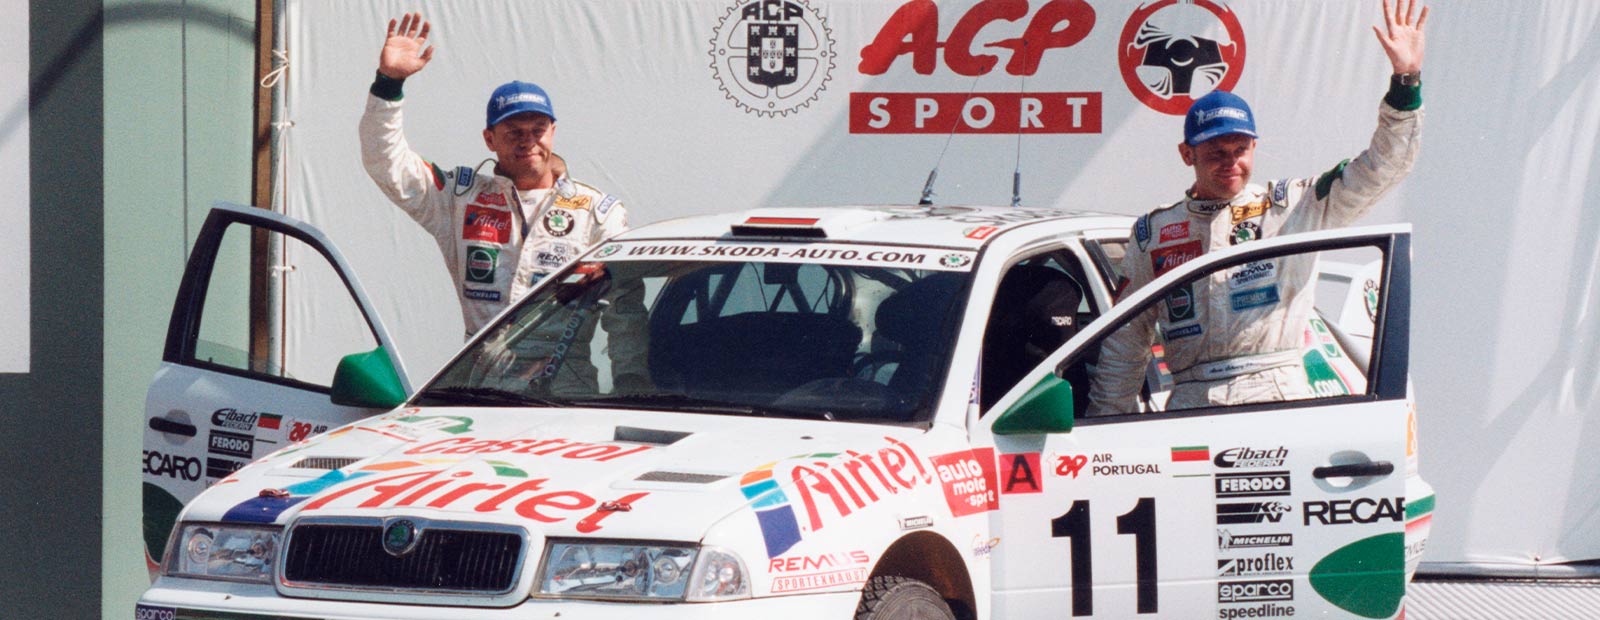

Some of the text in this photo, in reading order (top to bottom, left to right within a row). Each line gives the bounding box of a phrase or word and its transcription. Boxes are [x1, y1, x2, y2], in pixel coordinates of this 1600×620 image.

[742, 0, 804, 21] ACP
[858, 0, 1097, 77] ACP
[867, 96, 1089, 129] SPORT
[628, 244, 926, 264] WWW.SKODA-AUTO.COM
[210, 407, 258, 427] Eibach
[312, 425, 329, 434] AIR
[211, 435, 250, 452] FERODO
[404, 436, 652, 462] Castrol
[1091, 452, 1114, 464] AIR
[1213, 445, 1289, 468] Eibach
[937, 459, 983, 483] auto
[1005, 454, 1039, 492] A
[1092, 463, 1161, 476] PORTUGAL
[790, 436, 933, 532] Airtel
[1220, 476, 1286, 492] FERODO
[299, 469, 652, 534] Airtel
[1232, 534, 1292, 546] MICHELIN
[767, 549, 871, 574] REMUS
[1051, 497, 1158, 617] 11
[1237, 552, 1294, 577] proflex
[777, 568, 866, 591] SPORTEXHAUST
[1219, 582, 1292, 602] sparco
[1219, 602, 1296, 620] speedline
